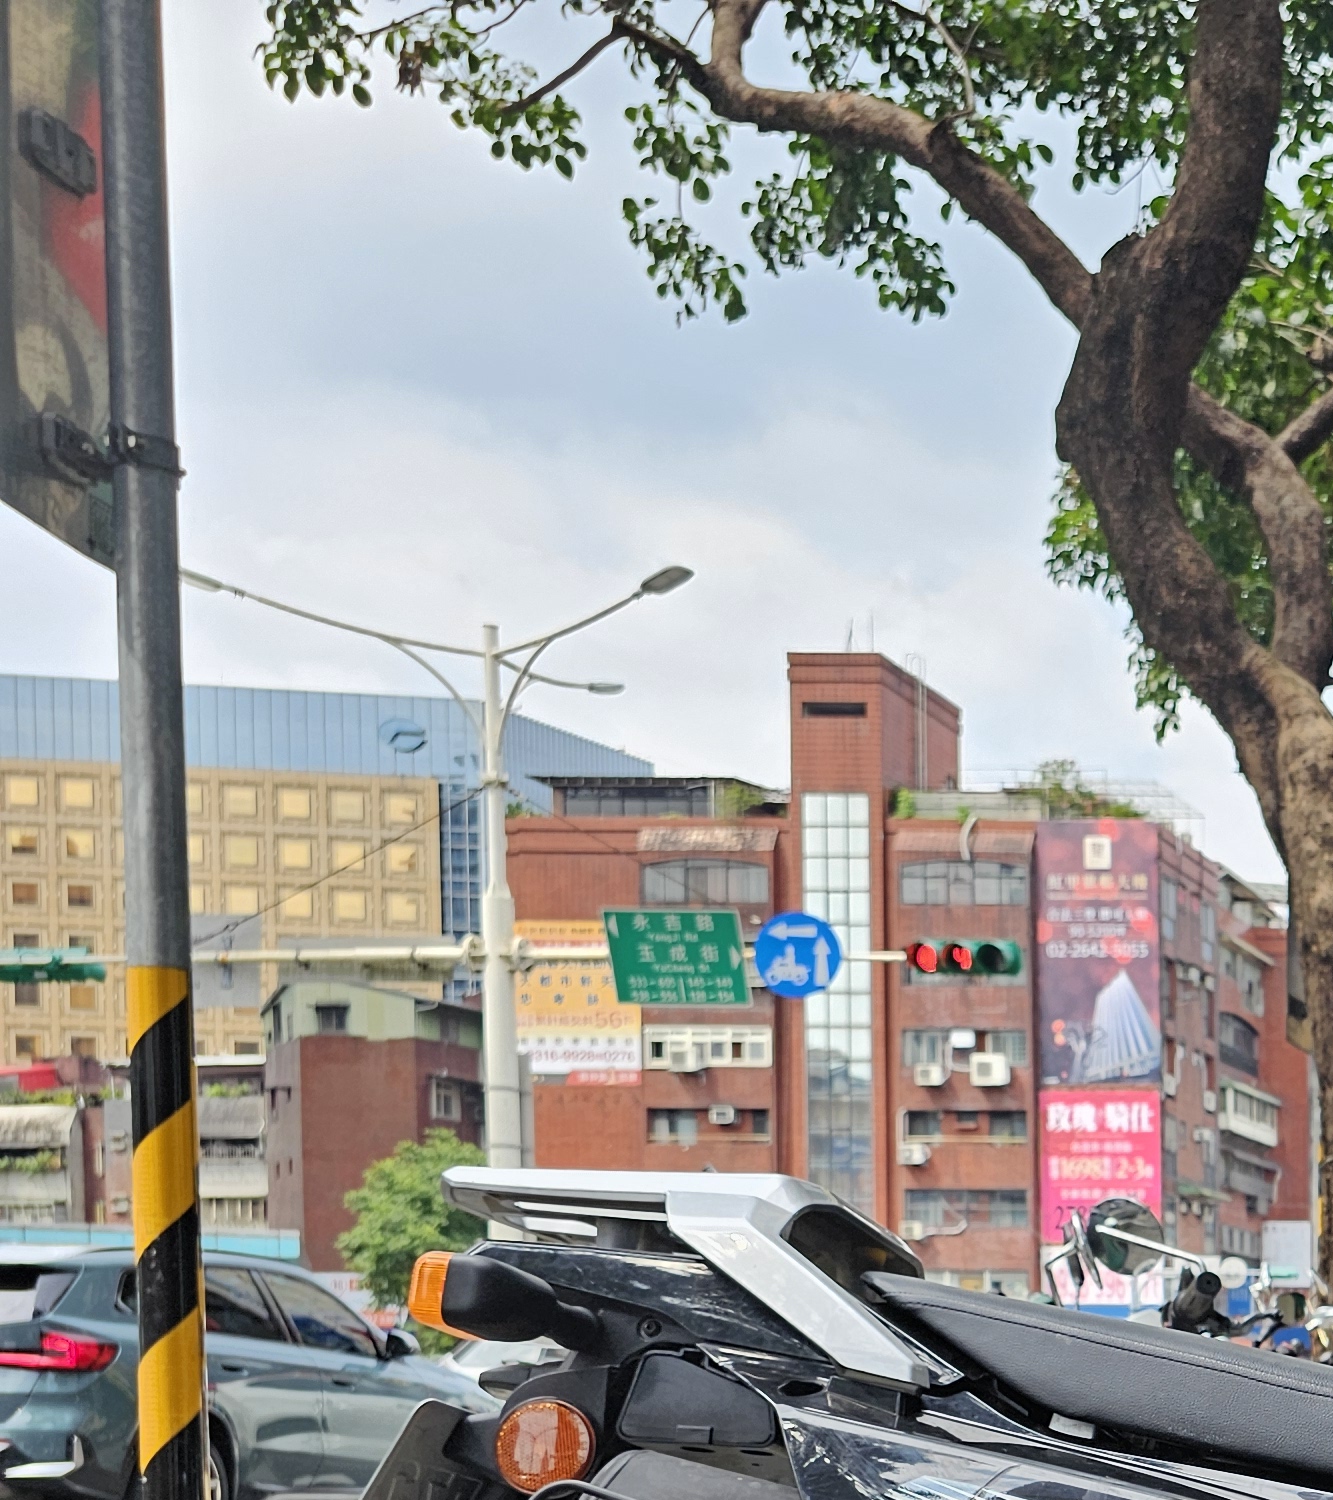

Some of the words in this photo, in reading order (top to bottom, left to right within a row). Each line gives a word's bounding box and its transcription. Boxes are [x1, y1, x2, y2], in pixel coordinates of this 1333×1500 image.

[632, 914, 715, 932] 永吉路
[637, 944, 719, 963] 玉成街
